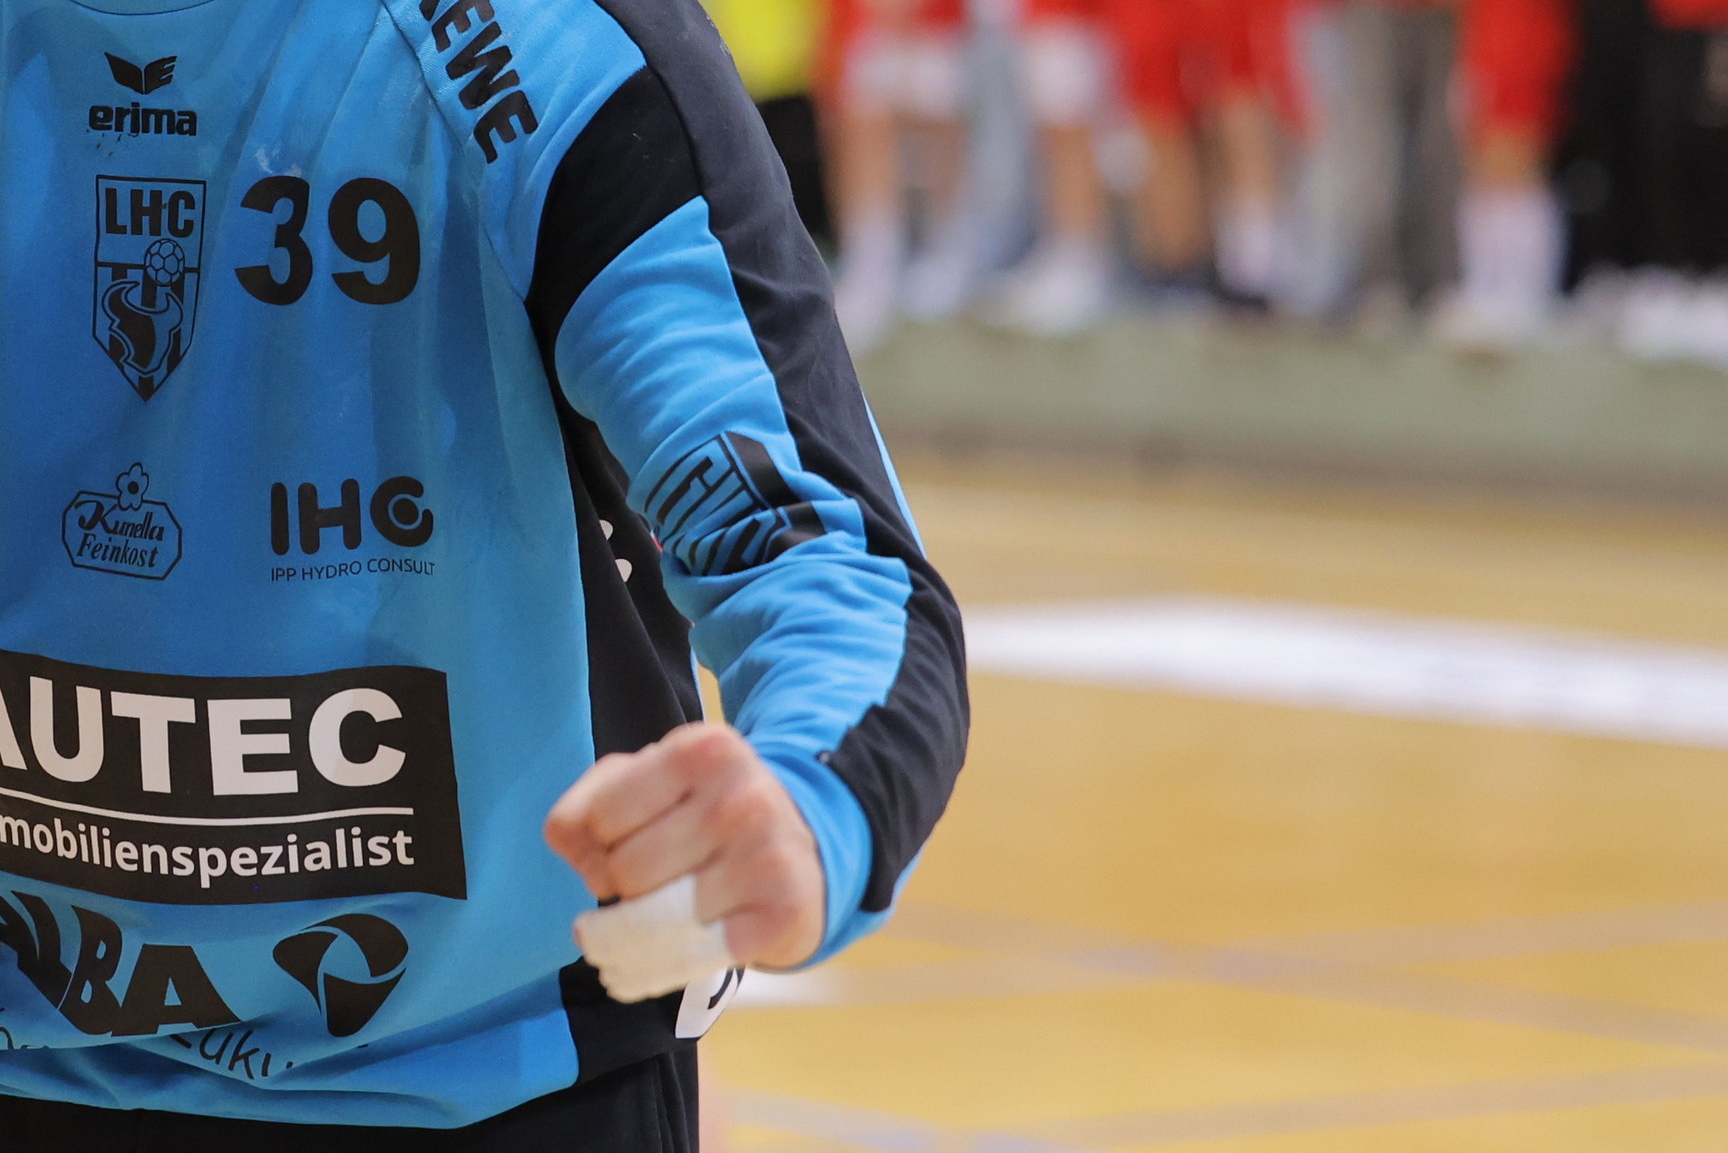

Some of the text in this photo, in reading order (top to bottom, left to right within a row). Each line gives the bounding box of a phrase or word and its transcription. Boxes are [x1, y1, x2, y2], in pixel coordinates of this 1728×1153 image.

[89, 102, 197, 136] erima
[105, 187, 196, 238] LHC
[235, 175, 419, 306] 39
[271, 475, 434, 556] IHC
[77, 533, 159, 568] Feinkost
[271, 558, 436, 582] IPP HYDRO CONSULT
